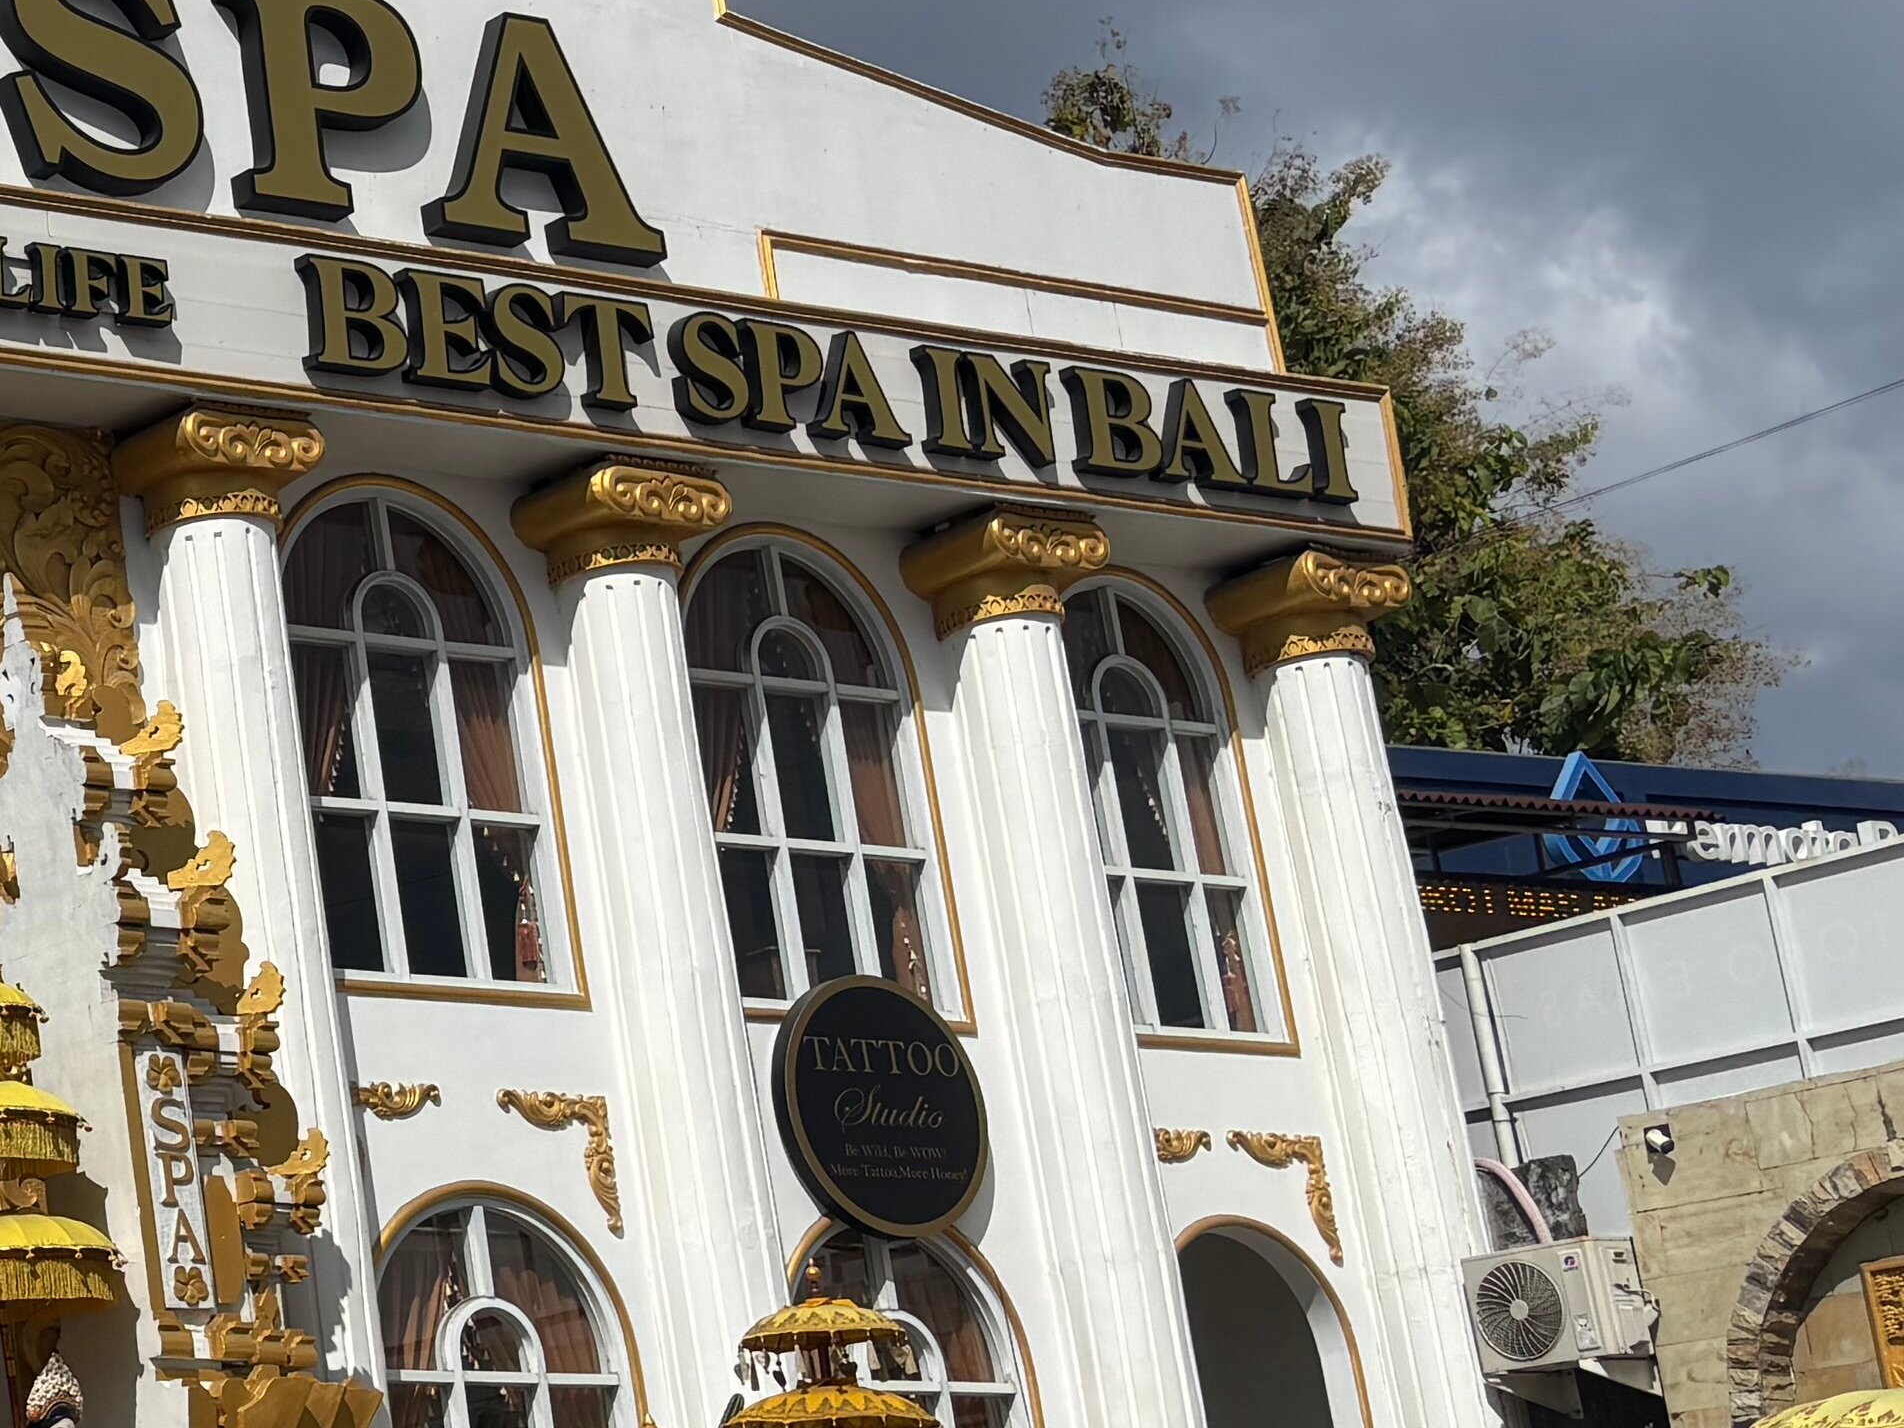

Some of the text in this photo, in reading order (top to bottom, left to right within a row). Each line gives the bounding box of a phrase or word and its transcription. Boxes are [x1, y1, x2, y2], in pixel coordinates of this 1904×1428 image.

[294, 253, 1360, 505] BEST SPA IN BALI
[803, 1035, 958, 1077] TATTOO
[834, 1085, 944, 1133] Studio
[150, 1097, 207, 1264] SPA
